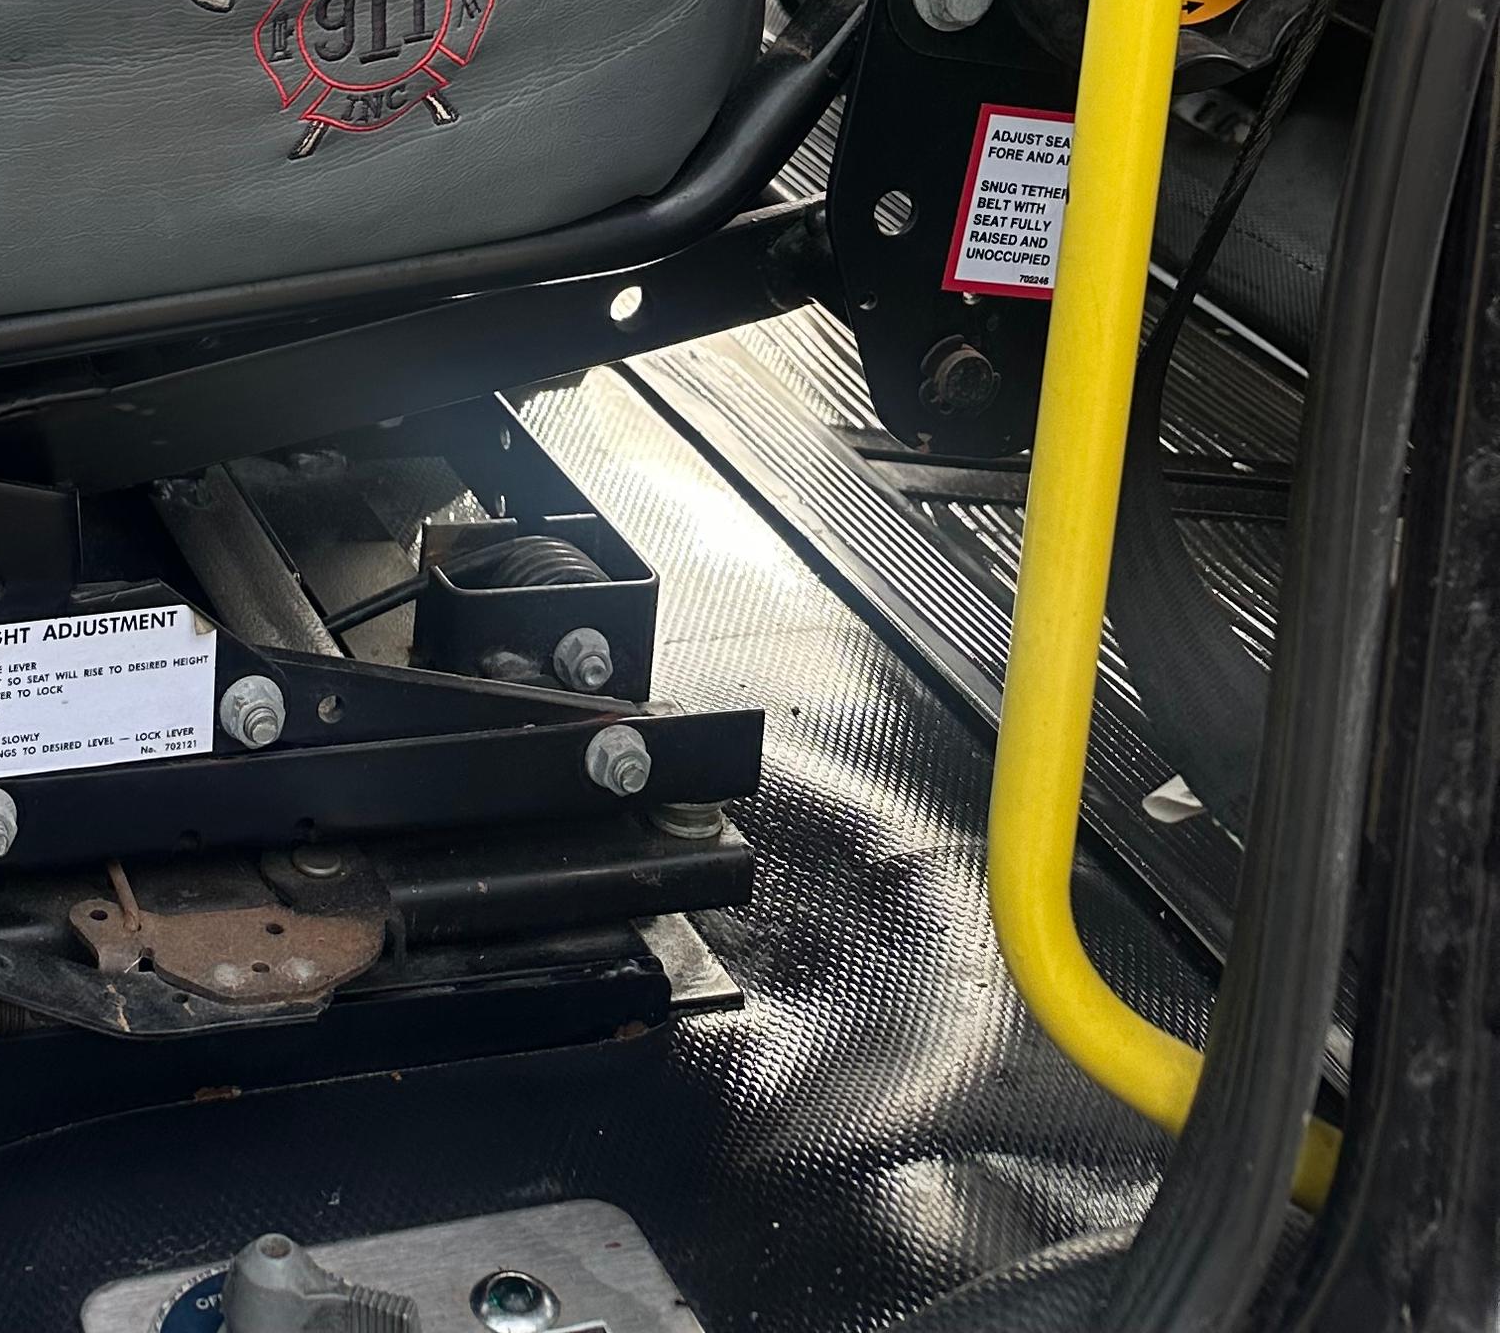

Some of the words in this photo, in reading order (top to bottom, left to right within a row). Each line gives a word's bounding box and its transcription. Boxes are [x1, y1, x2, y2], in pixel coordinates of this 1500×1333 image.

[341, 83, 409, 123] INC
[991, 129, 1044, 146] ADJUST
[1045, 135, 1074, 150] SEA
[987, 146, 1025, 161] FORE
[1026, 150, 1054, 165] AND
[980, 179, 1018, 195] SNUG
[976, 196, 1012, 212] BELT
[1014, 200, 1047, 215] WITH
[973, 213, 1009, 228] SEAT
[1010, 218, 1052, 233] FULLY
[969, 230, 1018, 246] RAISED
[1019, 234, 1049, 249] AND
[966, 247, 1051, 266] UNOCCUPIED
[43, 610, 178, 641] ADJUSTMENT
[7, 677, 21, 686] SO
[27, 673, 50, 684] SEAT
[55, 670, 78, 681] WILL
[83, 667, 103, 677] RISE
[109, 665, 122, 675] TO
[128, 659, 167, 673] DESIRED
[172, 655, 209, 667] HEIGHT
[8, 662, 37, 673] LEVER
[18, 689, 31, 698] TO
[37, 685, 63, 696] LOCK
[1, 733, 40, 745] SLOWLY
[23, 746, 37, 755] TO
[42, 741, 82, 753] DESIRED
[87, 736, 114, 748] LEVEL
[135, 731, 162, 742] LOCK
[166, 727, 194, 738] LEVER
[140, 745, 157, 755] No.
[165, 739, 197, 751] 702121
